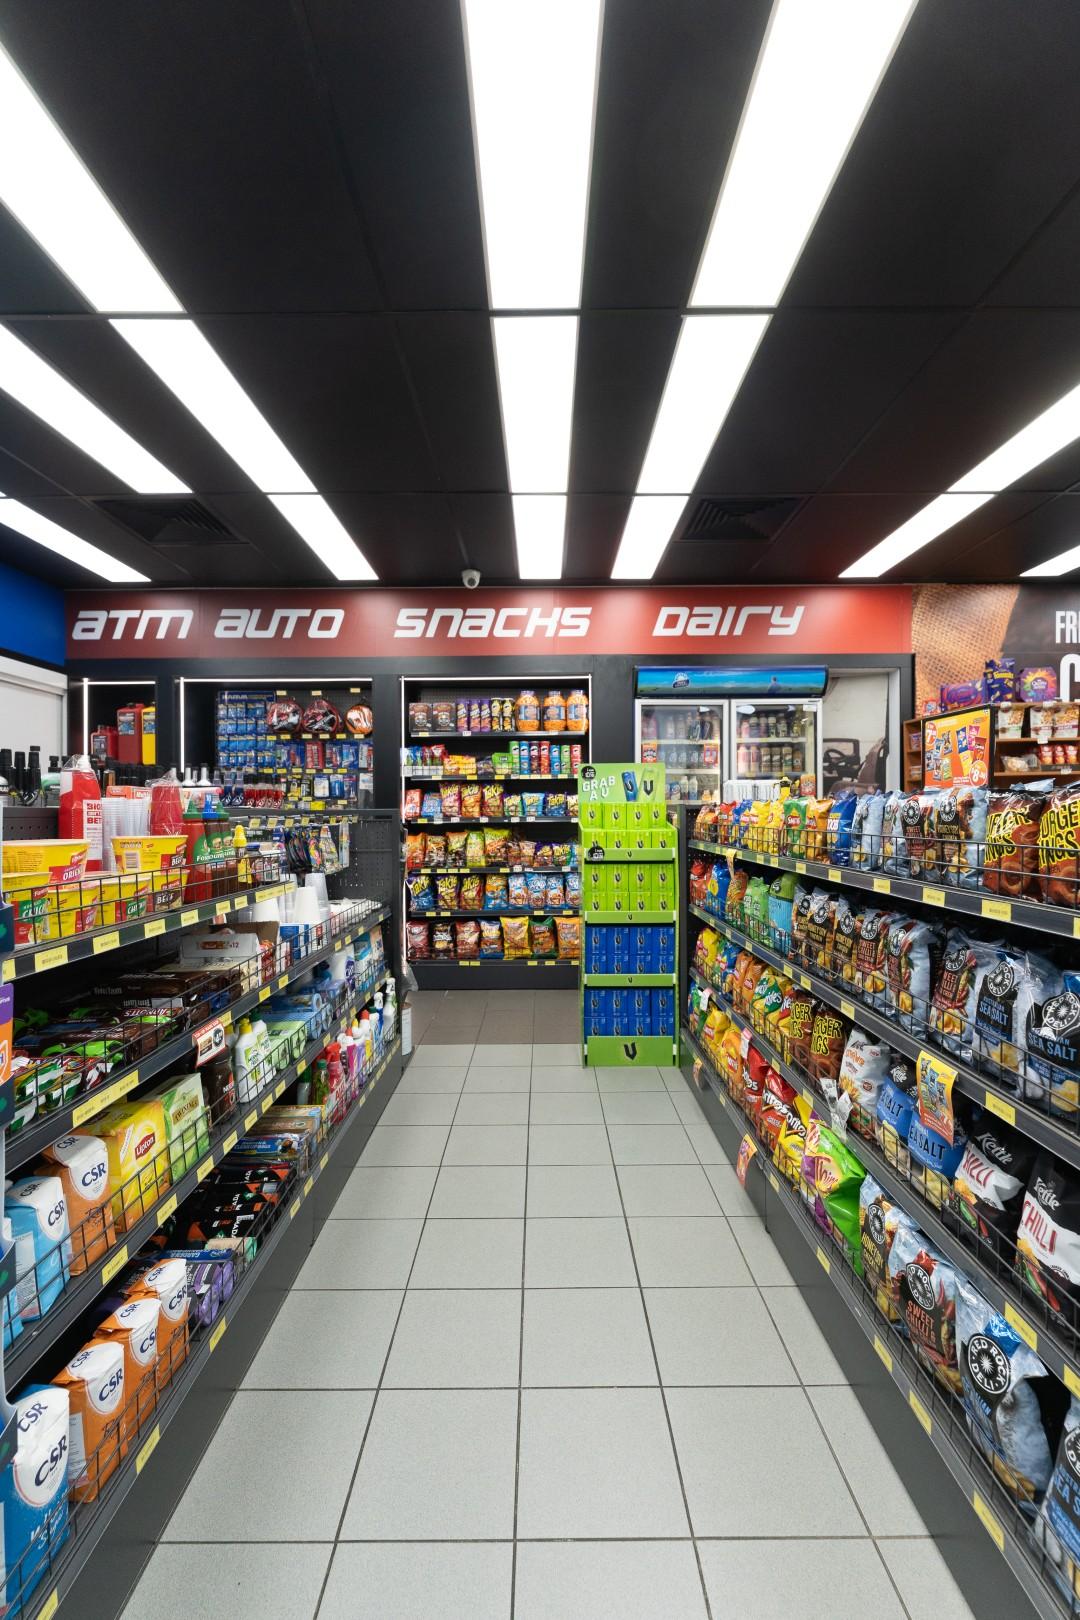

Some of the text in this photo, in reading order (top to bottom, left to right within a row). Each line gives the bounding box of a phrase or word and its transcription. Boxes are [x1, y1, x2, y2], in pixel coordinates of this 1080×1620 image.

[1048, 1015, 1070, 1030] DELI
[1045, 1040, 1078, 1062] SALT
[136, 1135, 155, 1158] Lipton
[973, 1131, 1014, 1165] Kettle
[81, 1163, 107, 1187] CSR
[48, 1199, 65, 1227] CSR
[120, 1303, 142, 1319] CSR
[907, 1300, 935, 1329] SWEET
[971, 1340, 1008, 1387] RED ROCK
[971, 1362, 995, 1390] DELI
[98, 1367, 124, 1402] CSR
[17, 1402, 49, 1433] CSR
[34, 1434, 68, 1487] CSR
